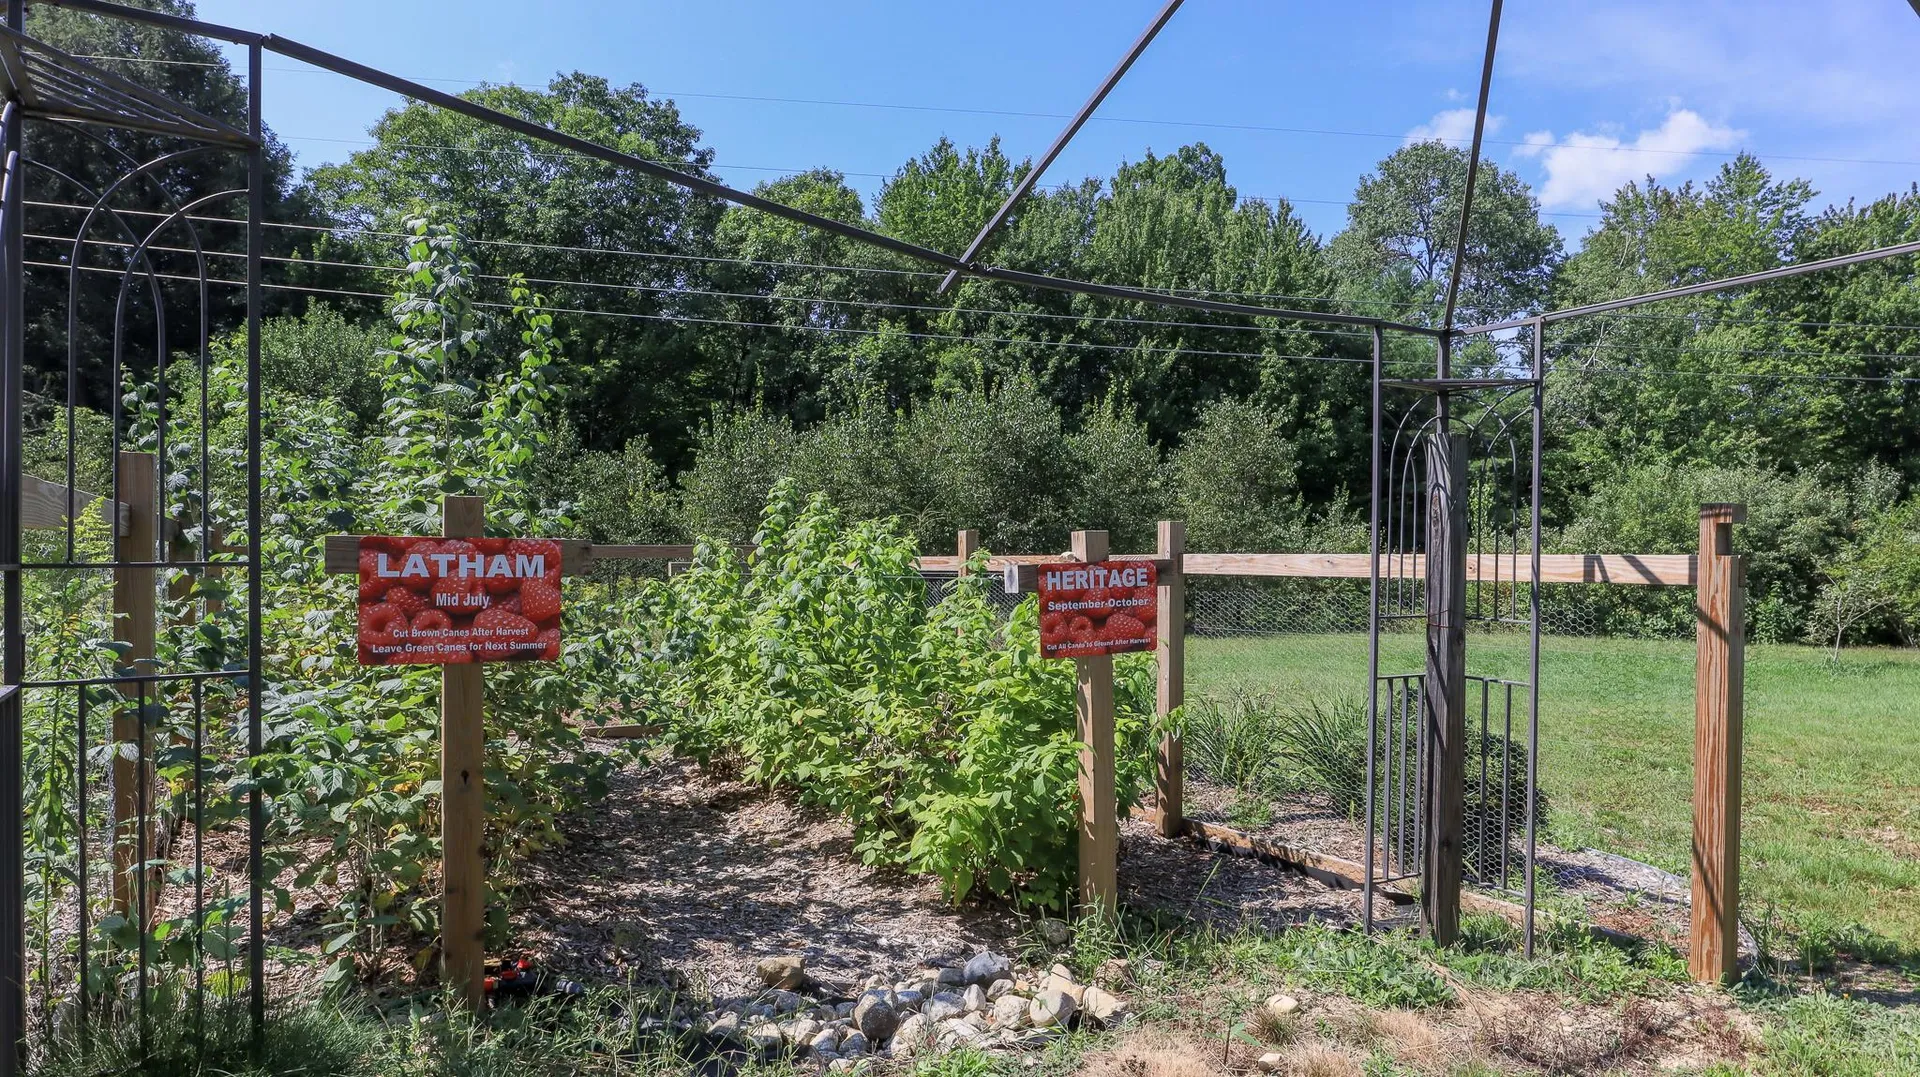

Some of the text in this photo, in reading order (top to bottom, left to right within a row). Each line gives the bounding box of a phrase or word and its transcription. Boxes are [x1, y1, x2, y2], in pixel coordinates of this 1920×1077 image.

[377, 553, 545, 578] LATHAM
[1046, 568, 1148, 591] HERITAGE
[436, 592, 490, 609] Mid July
[1048, 598, 1149, 612] September-October
[393, 627, 529, 638] Cut Brown Canes After Harvest
[372, 641, 547, 653] Leave Green Canes for Next Summer
[1129, 637, 1151, 645] Harvest
